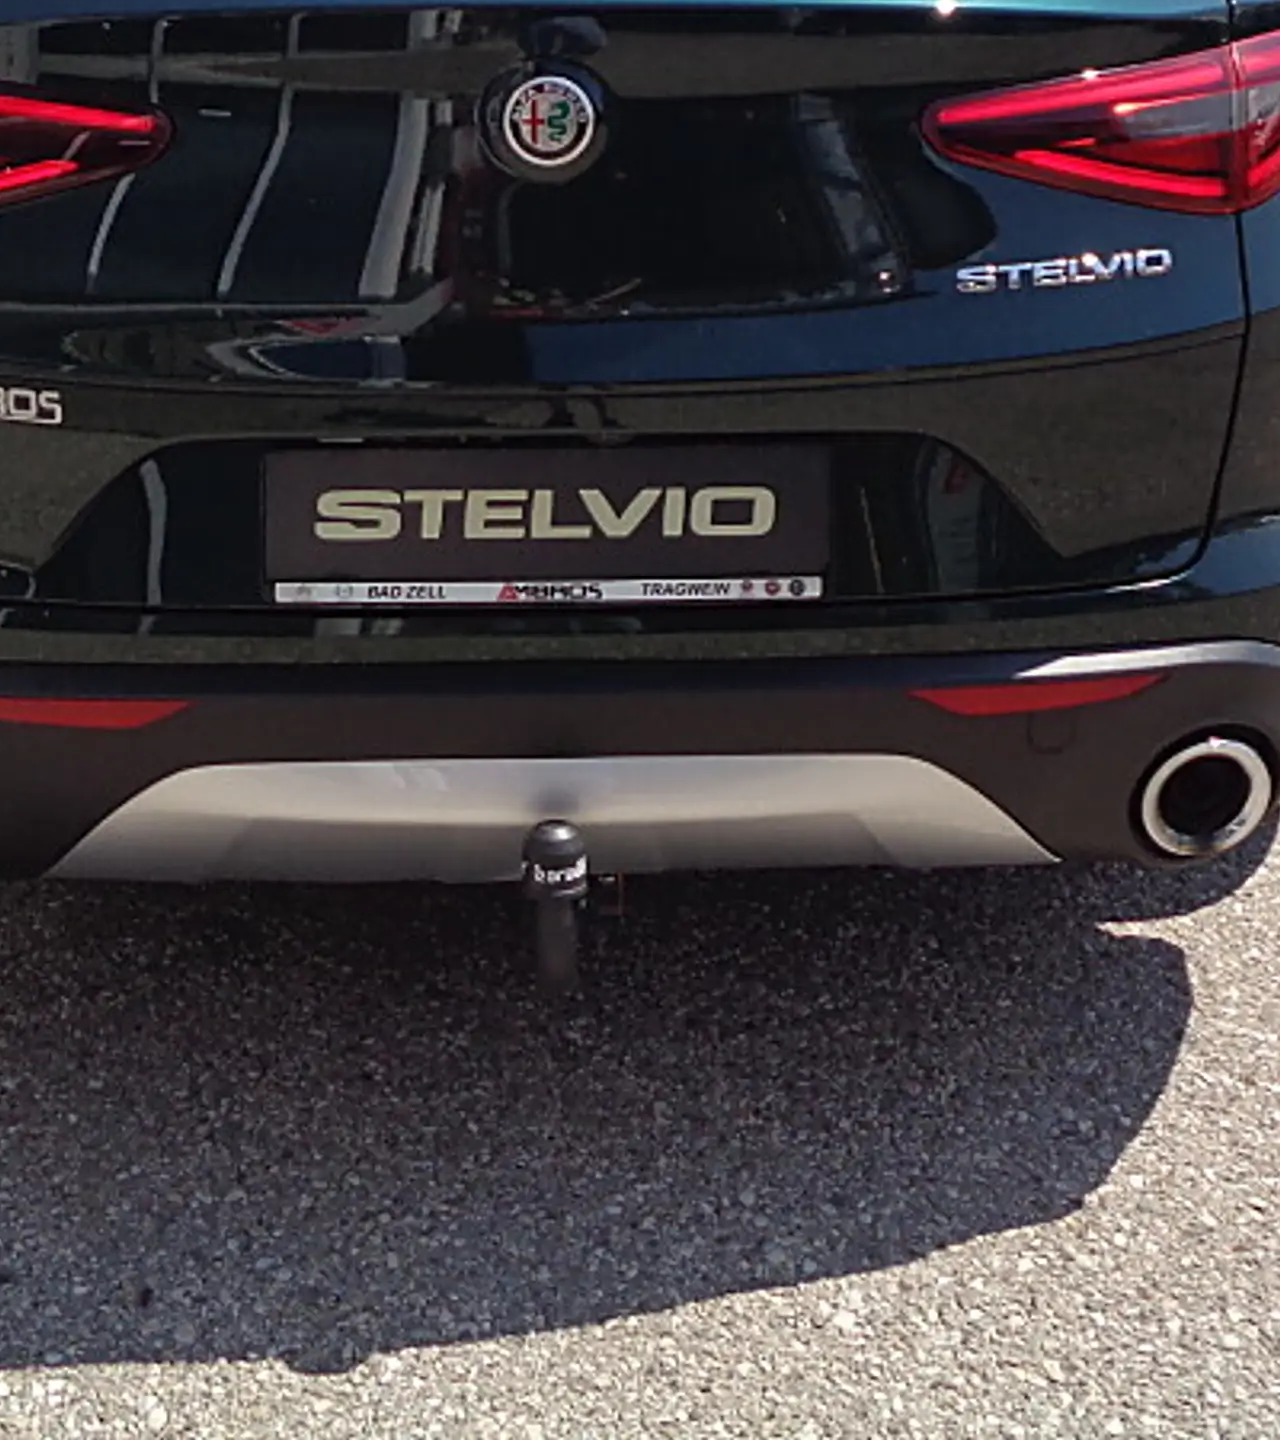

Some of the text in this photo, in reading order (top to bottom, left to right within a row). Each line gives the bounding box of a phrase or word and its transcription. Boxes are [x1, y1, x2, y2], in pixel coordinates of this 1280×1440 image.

[956, 248, 1173, 293] STELVIO
[314, 486, 776, 541] STELVIO
[367, 582, 731, 601] BAD ZELL AMBROS TRAGWEIN
